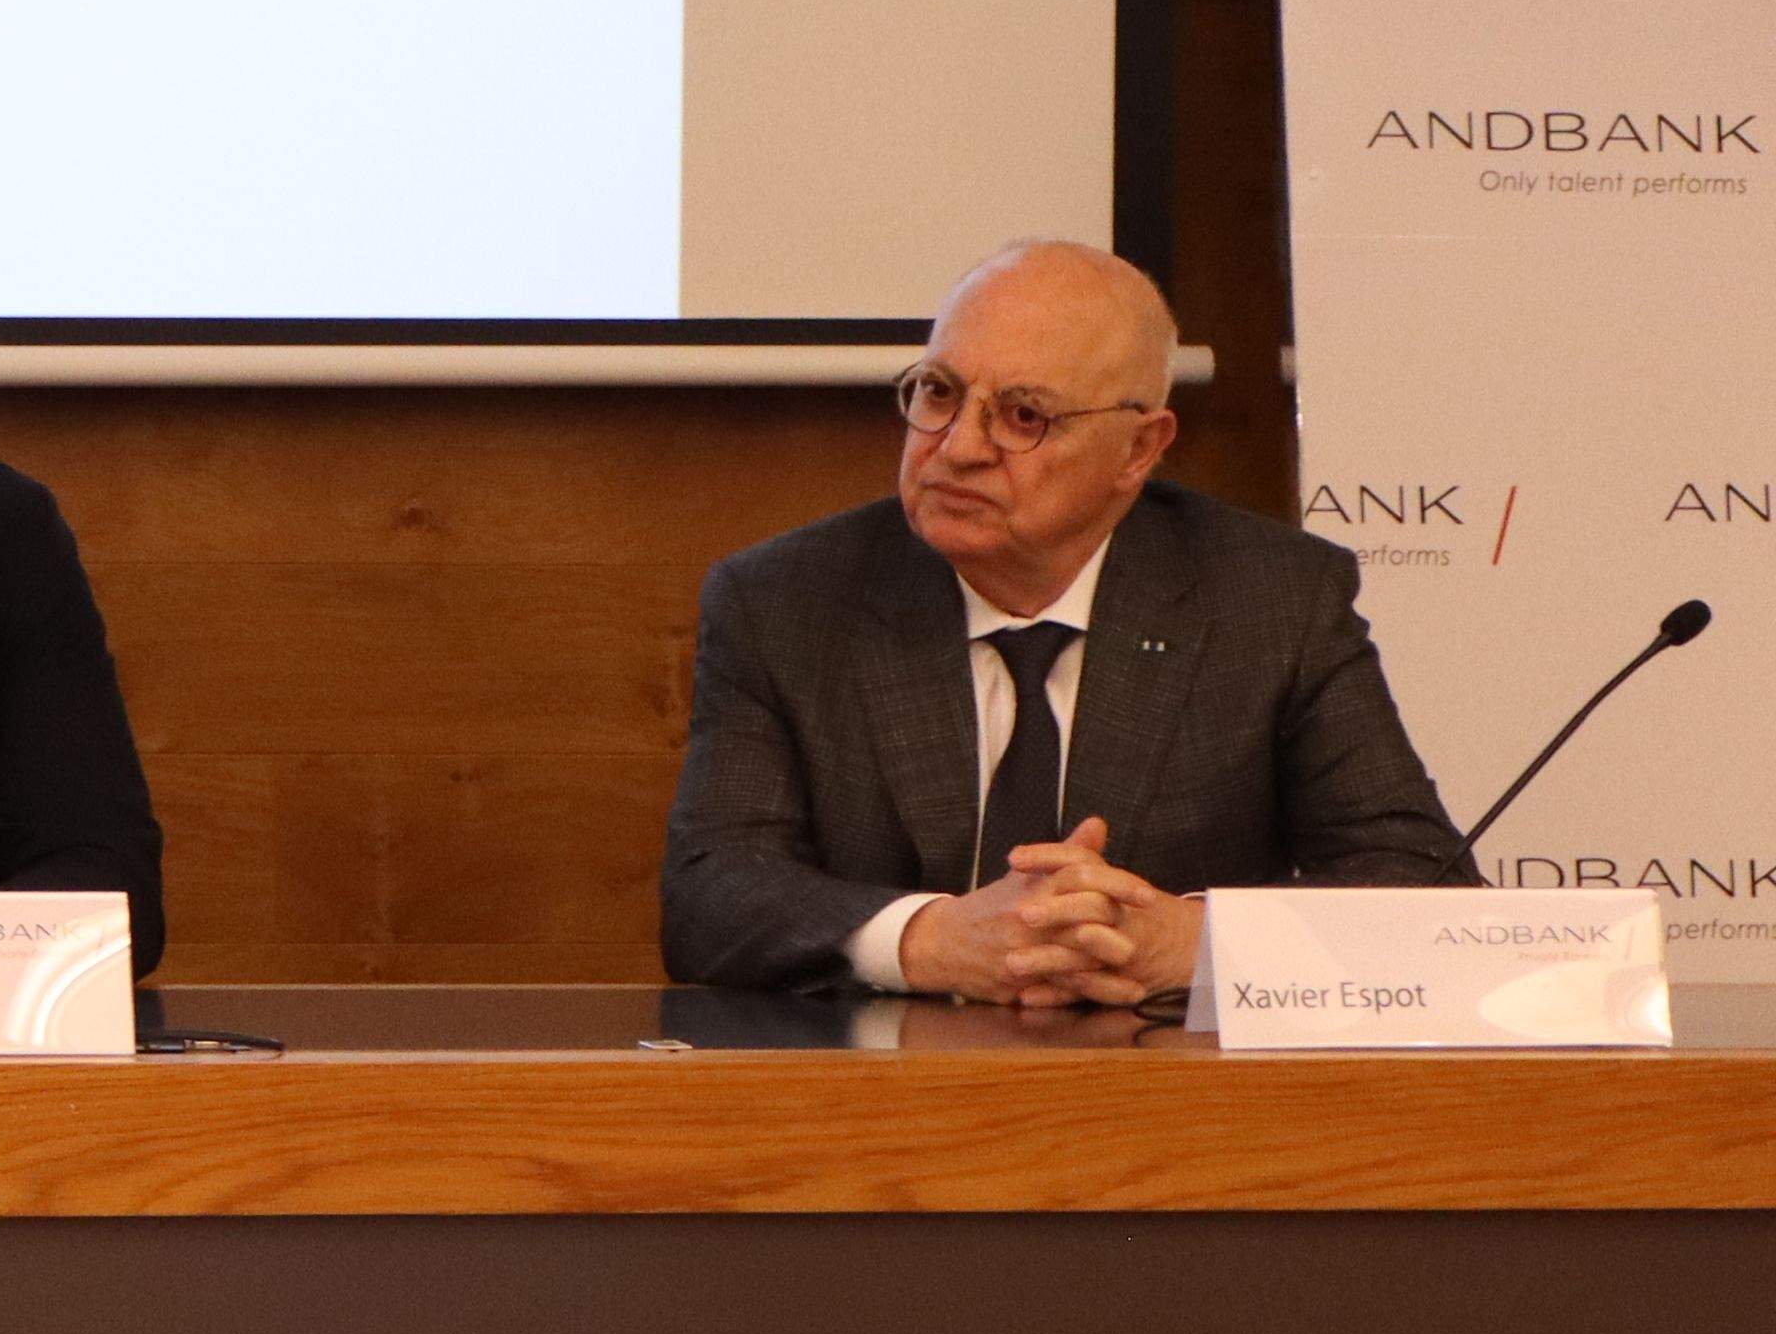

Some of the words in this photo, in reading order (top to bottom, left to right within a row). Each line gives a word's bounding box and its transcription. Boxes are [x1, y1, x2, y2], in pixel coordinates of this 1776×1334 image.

[1366, 110, 1761, 154] ANDBANK
[1478, 169, 1538, 196] Only
[1548, 171, 1624, 193] talent
[1632, 171, 1748, 198] performs
[1304, 484, 1464, 525] ANK
[1664, 482, 1771, 523] AN
[1432, 924, 1612, 945] ANDBANK
[1233, 982, 1330, 1009] Xavier
[1339, 981, 1427, 1015] Espot
